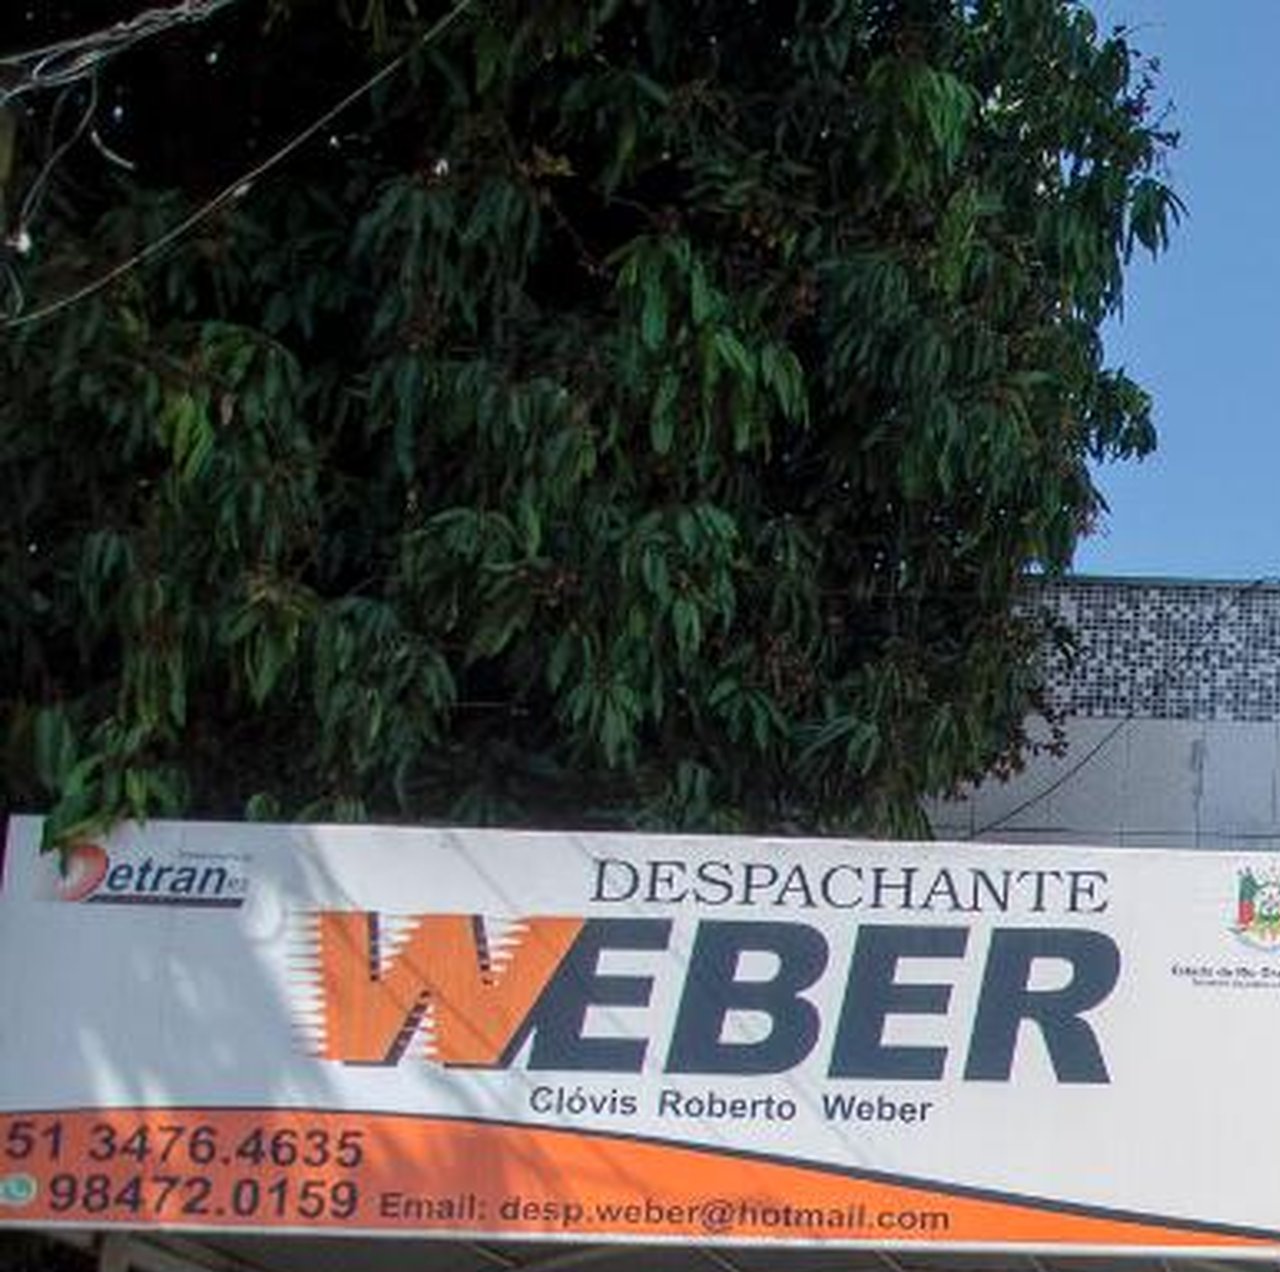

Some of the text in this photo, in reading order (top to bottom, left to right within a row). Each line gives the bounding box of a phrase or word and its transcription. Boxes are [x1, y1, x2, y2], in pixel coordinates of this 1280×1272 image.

[591, 860, 1109, 914] DESPACHANTE
[296, 908, 1121, 1084] WEBER
[529, 1085, 934, 1124] Clóvis Roberto Weber
[6, 1121, 364, 1169] 51 3476.4635
[50, 1174, 950, 1232] 98472.0159 Email: desp.weber@hotmail.com
